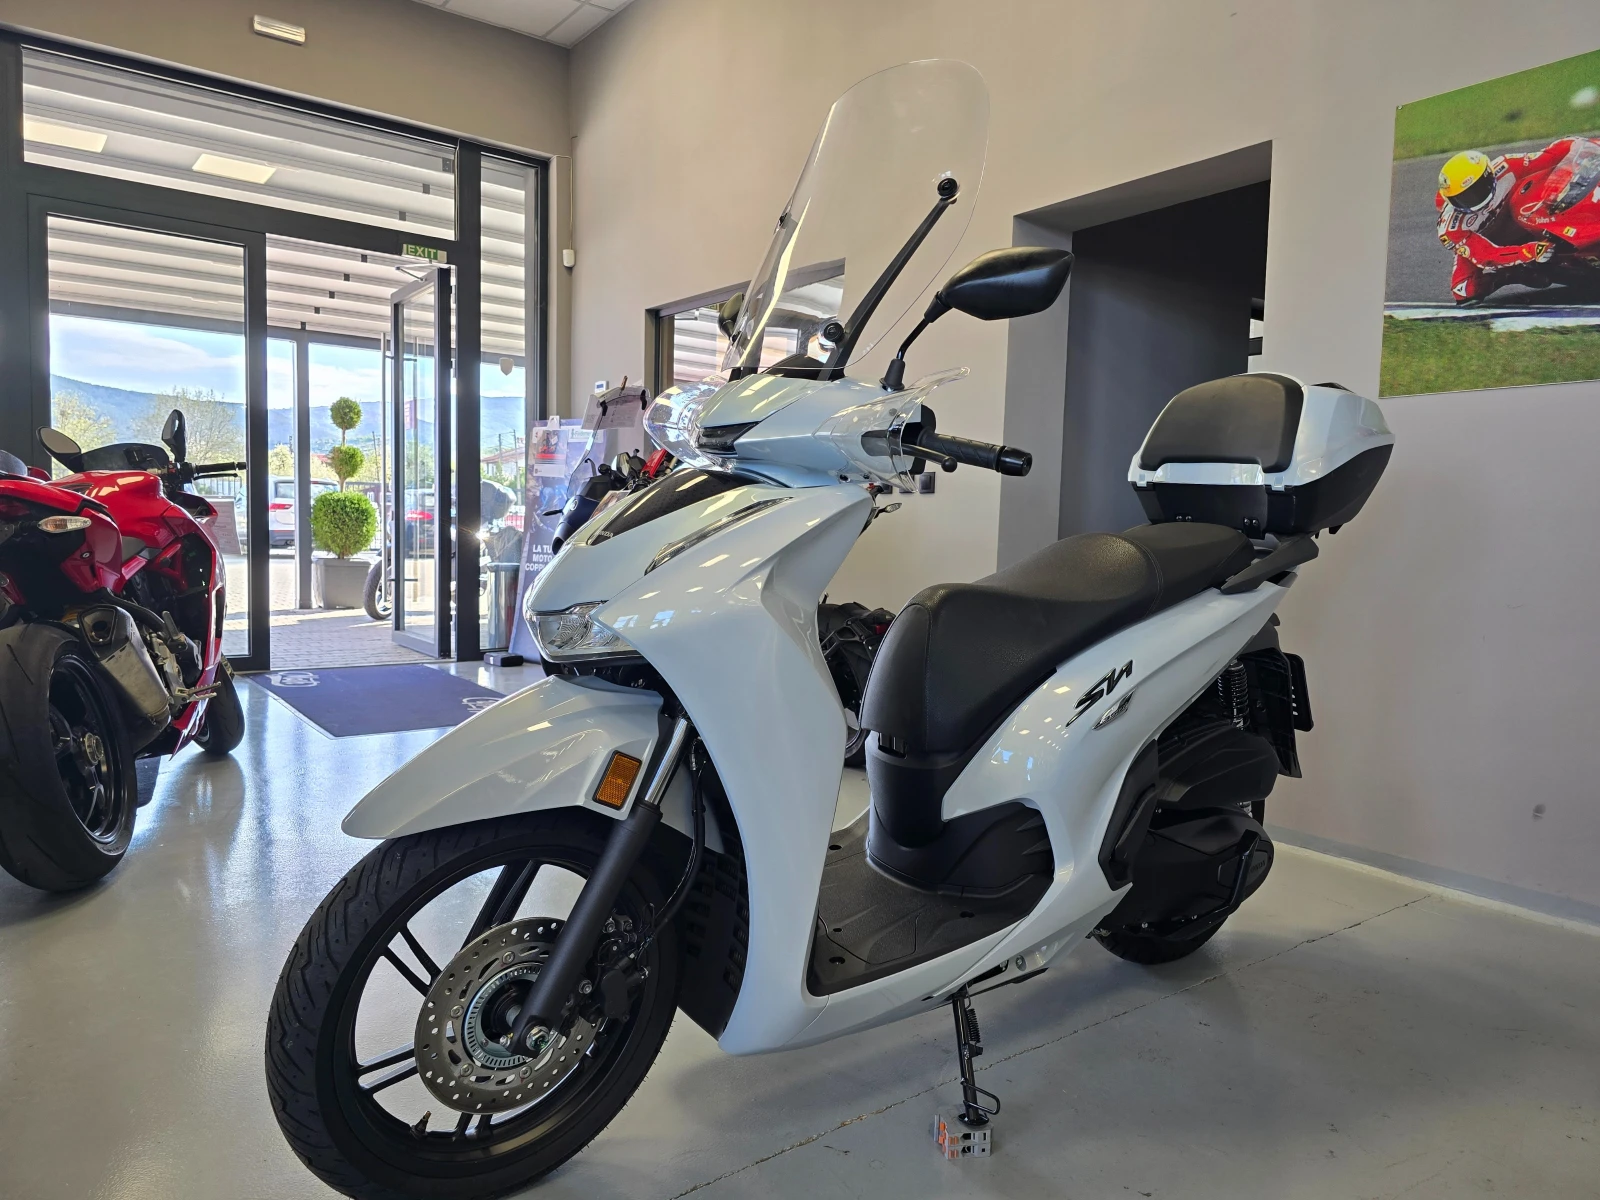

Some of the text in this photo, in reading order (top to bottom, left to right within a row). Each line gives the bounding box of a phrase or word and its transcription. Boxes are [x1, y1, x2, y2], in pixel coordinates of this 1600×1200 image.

[407, 245, 437, 259] EXIT
[533, 544, 541, 553] LA
[533, 554, 552, 562] MOTO
